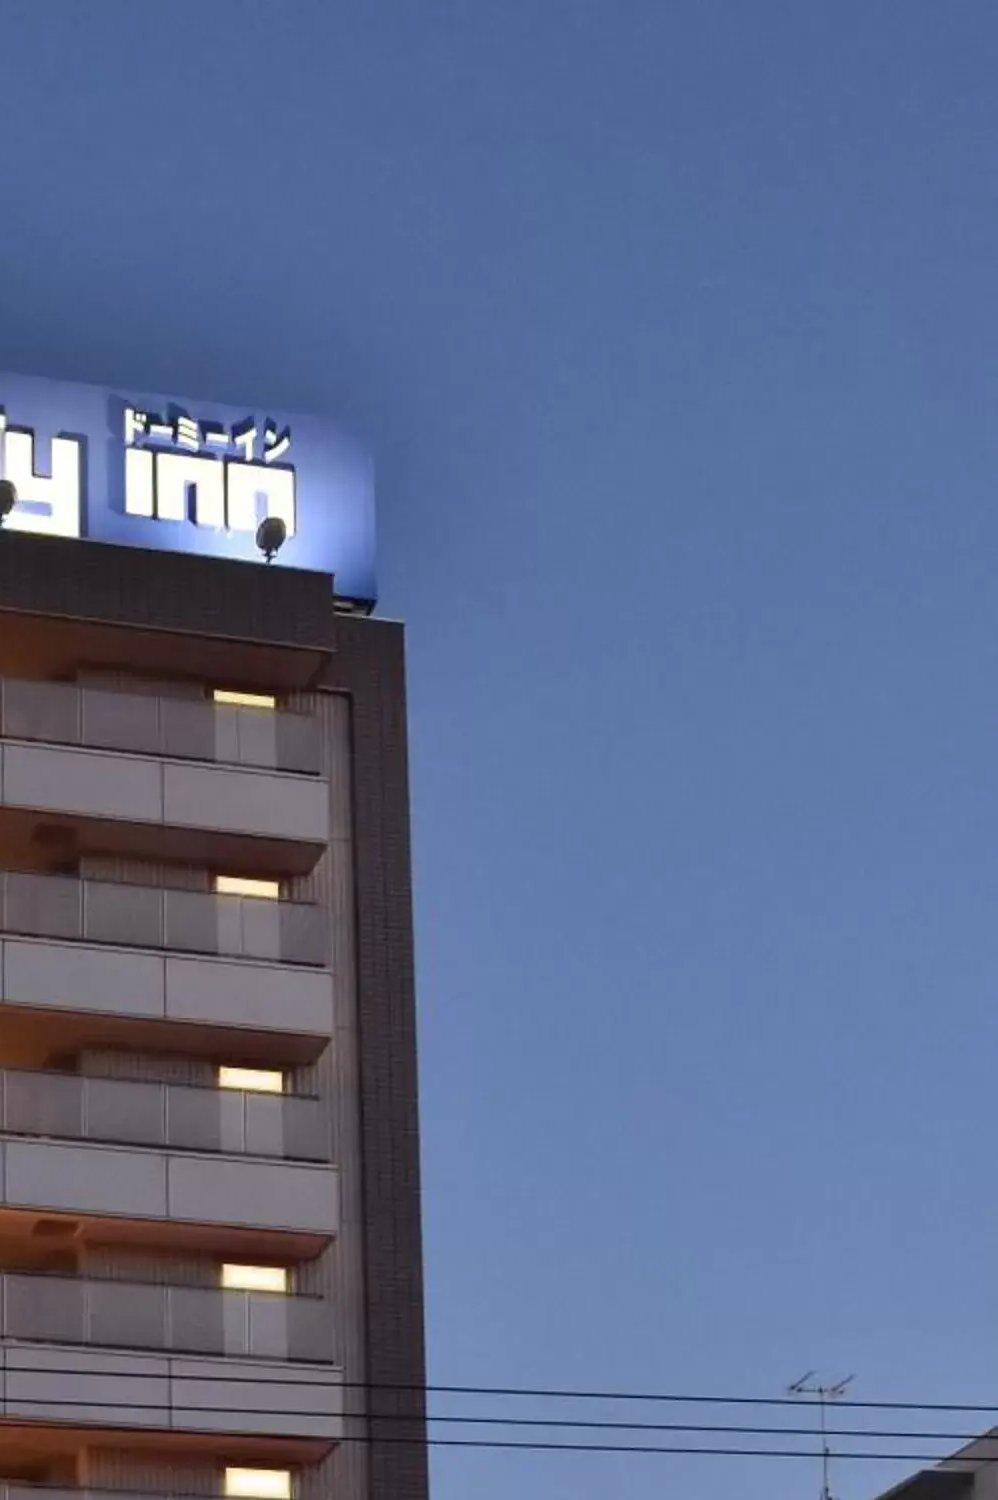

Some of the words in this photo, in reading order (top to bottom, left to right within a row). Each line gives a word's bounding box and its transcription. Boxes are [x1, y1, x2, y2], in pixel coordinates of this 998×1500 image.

[124, 409, 290, 460] ドーミーイン
[124, 446, 296, 538] inn
